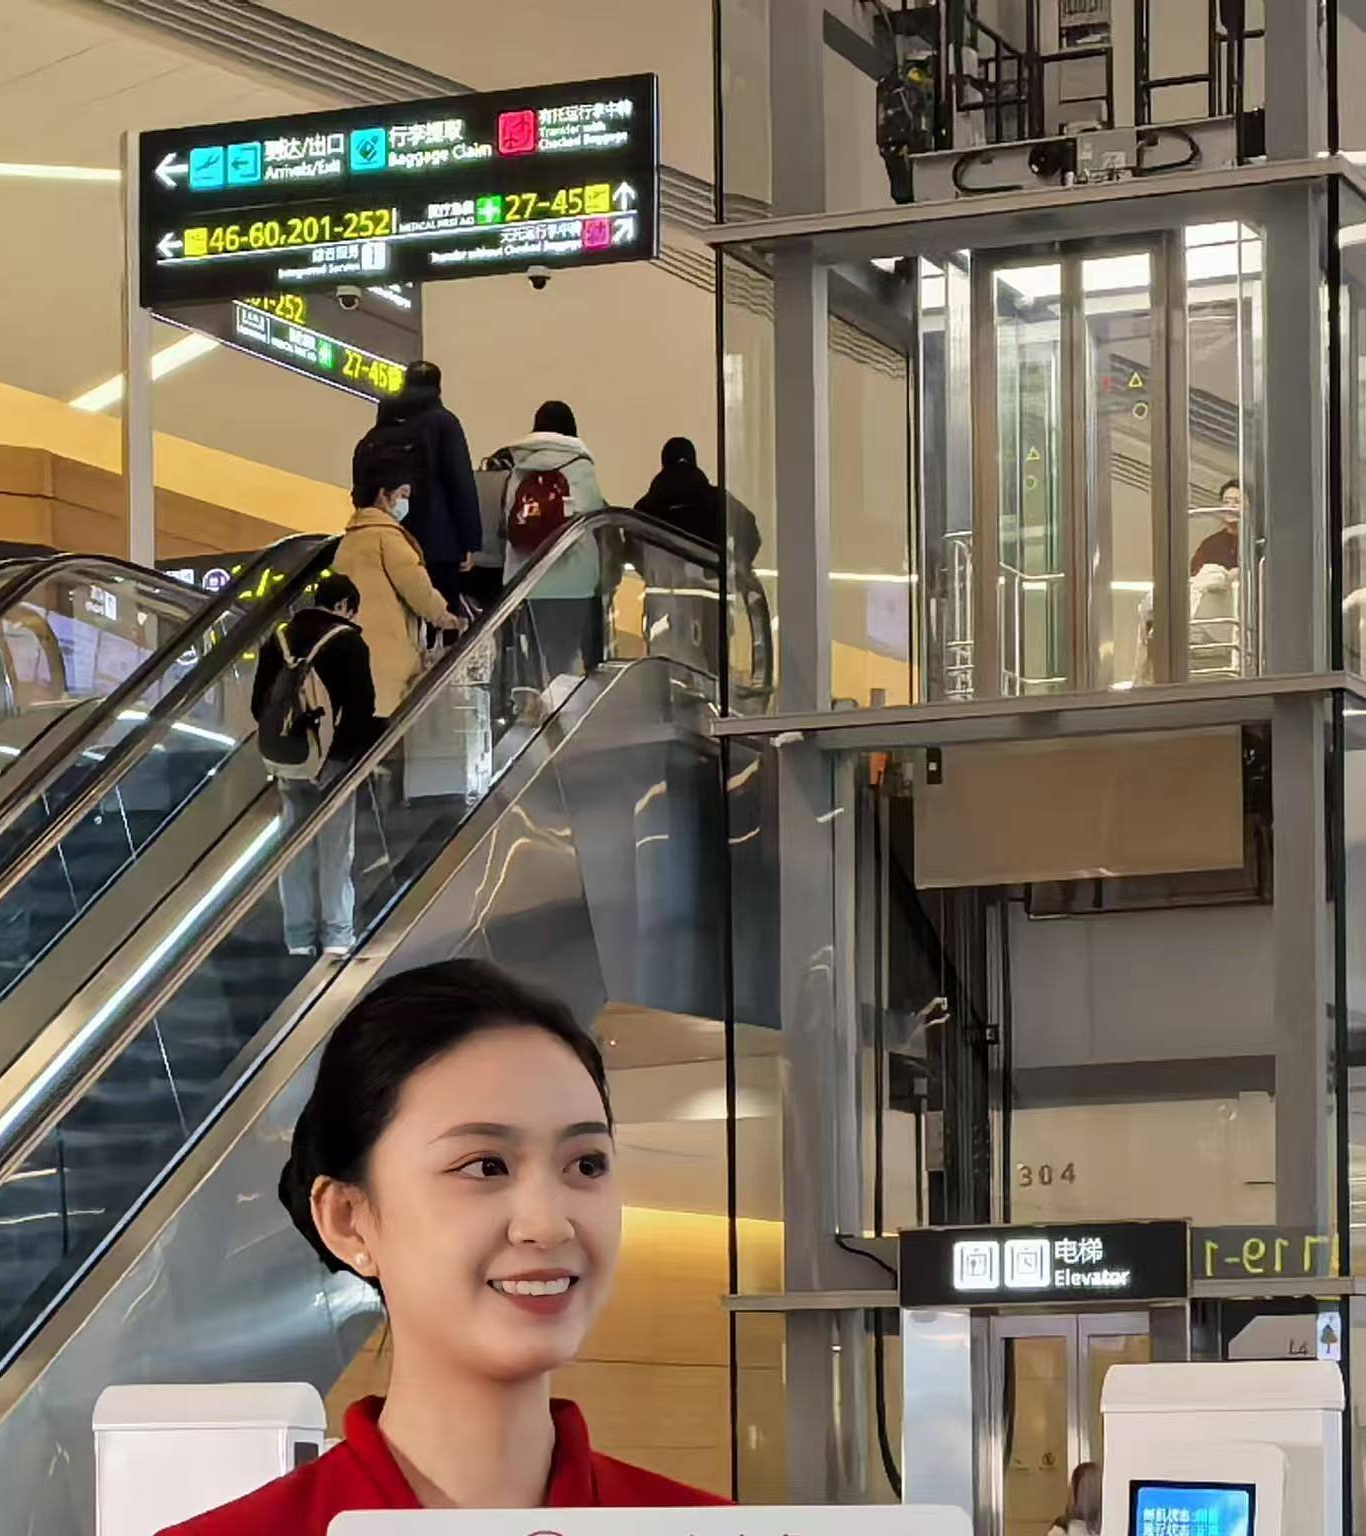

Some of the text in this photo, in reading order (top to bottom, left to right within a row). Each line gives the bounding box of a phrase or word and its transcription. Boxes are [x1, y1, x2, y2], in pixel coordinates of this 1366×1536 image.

[263, 132, 345, 162] 到达/出口
[388, 118, 464, 148] 行李提取
[387, 142, 493, 168] Baggage Claim
[504, 187, 584, 221] 27-45
[209, 208, 390, 252] 46-60,201-252
[342, 347, 388, 388] 27-45
[1018, 1162, 1076, 1188] 304
[1054, 1237, 1103, 1264] 电梯
[1054, 1268, 1131, 1287] Elevator
